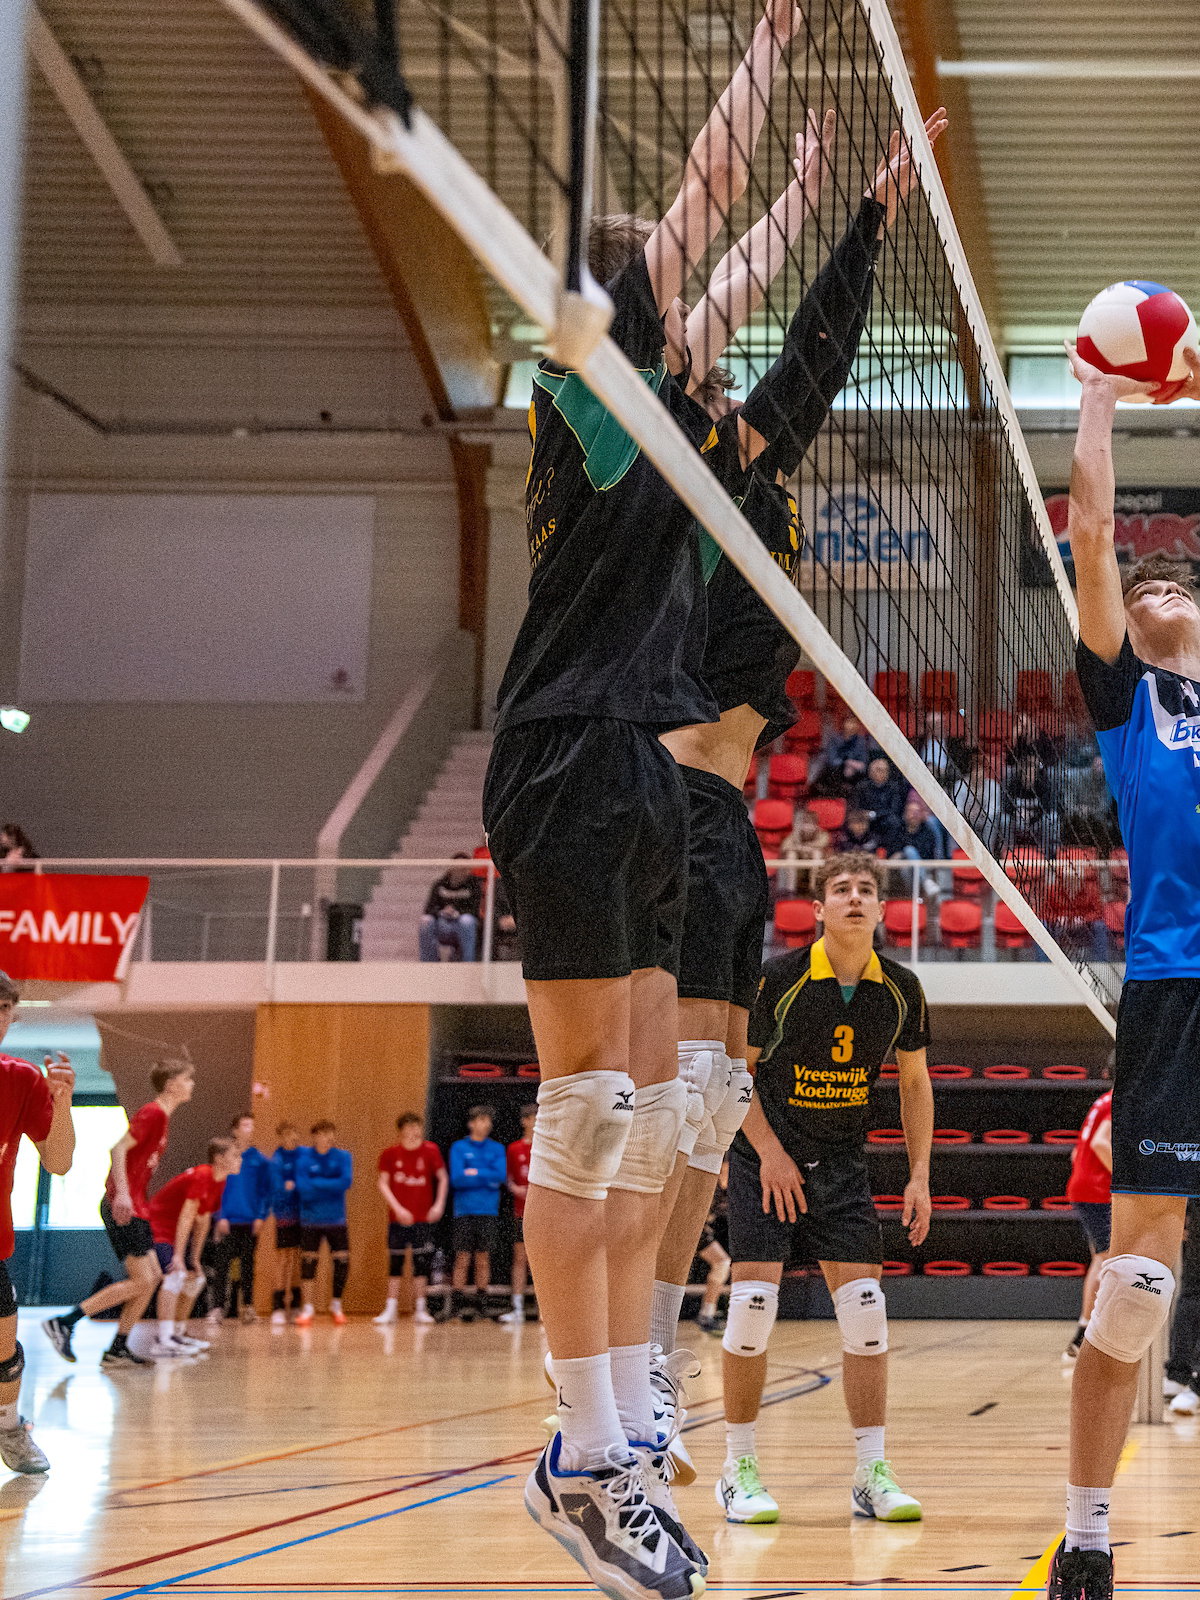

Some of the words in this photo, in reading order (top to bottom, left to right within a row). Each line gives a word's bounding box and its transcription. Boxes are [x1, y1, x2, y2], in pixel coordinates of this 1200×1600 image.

[831, 1025, 855, 1063] 3
[793, 1064, 869, 1087] Vreeswijk
[794, 1081, 869, 1102] Koebrugg
[1131, 1281, 1162, 1295] MIZUNO
